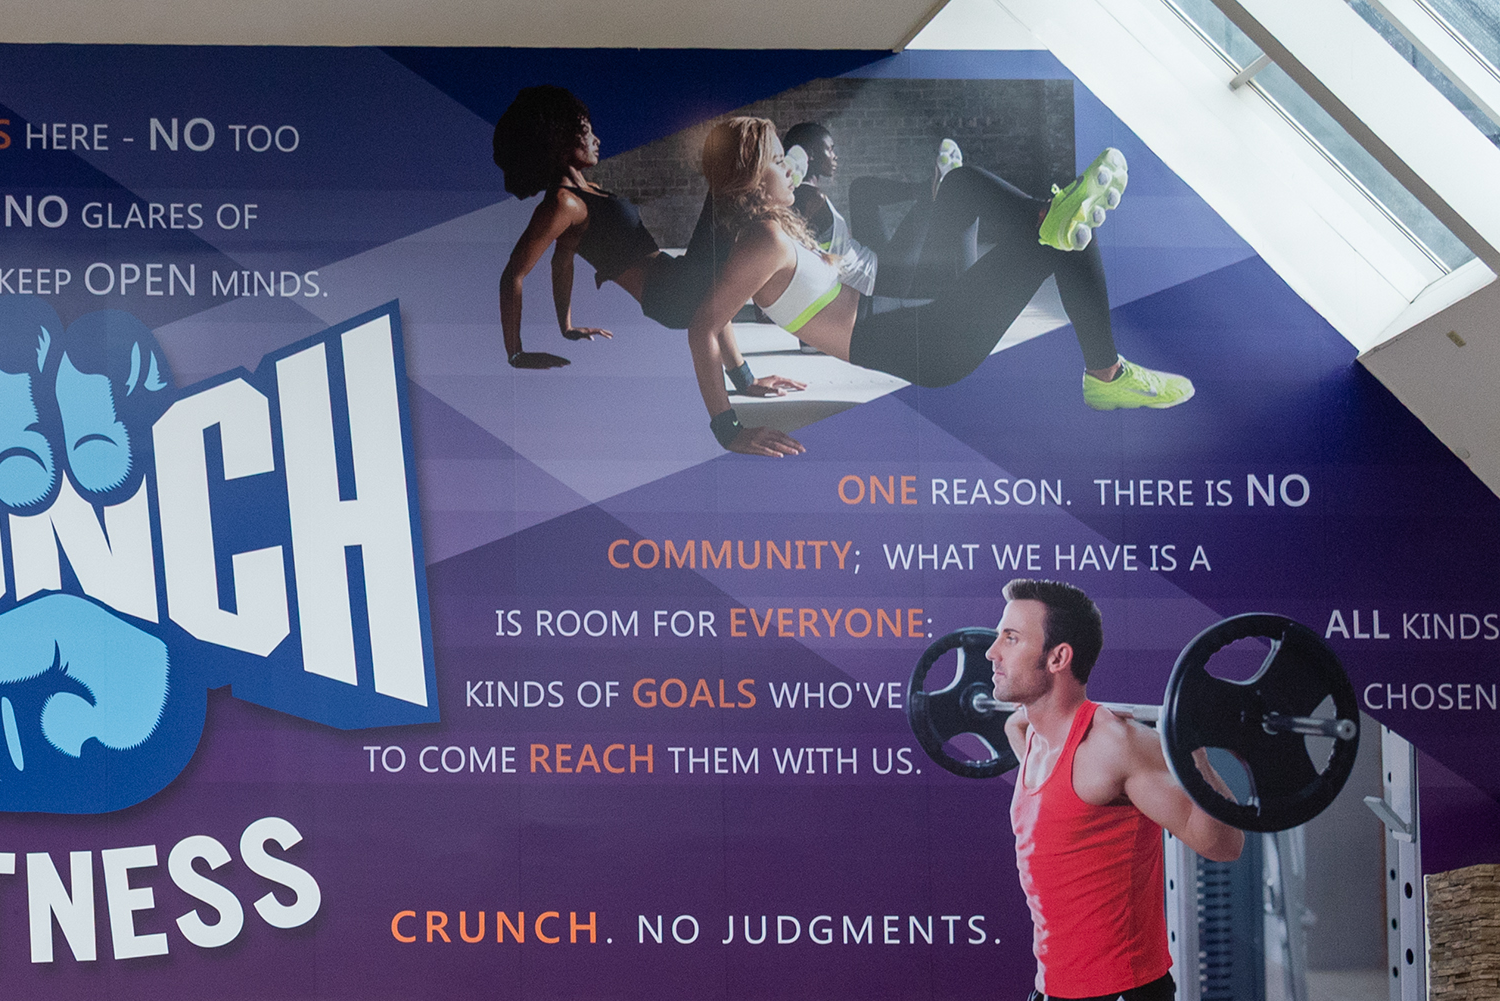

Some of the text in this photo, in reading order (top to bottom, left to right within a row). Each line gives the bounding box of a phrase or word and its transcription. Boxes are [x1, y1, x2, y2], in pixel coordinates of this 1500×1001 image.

[25, 122, 109, 151] HERE
[149, 117, 216, 152] NO
[227, 124, 300, 153] TOO
[4, 194, 69, 229] NO
[81, 201, 204, 230] GLARES
[215, 202, 259, 230] OF
[84, 262, 196, 296] OPEN
[211, 269, 329, 298] MINDS.
[837, 473, 1311, 508] ONE REASON. THERE IS NO
[607, 538, 1212, 574] COMMUNITY; WHAT WE HAVE IS A
[495, 607, 1500, 641] IS ROOM FOR EVERYONE: ALL KINDS
[466, 677, 1498, 711] KINDS OF GOALS WHO'VE CHOSEN
[363, 743, 922, 775] TO COME REACH THEM WITH US.
[390, 909, 1001, 945] CRUNCH. NO JUDGMENTS.
